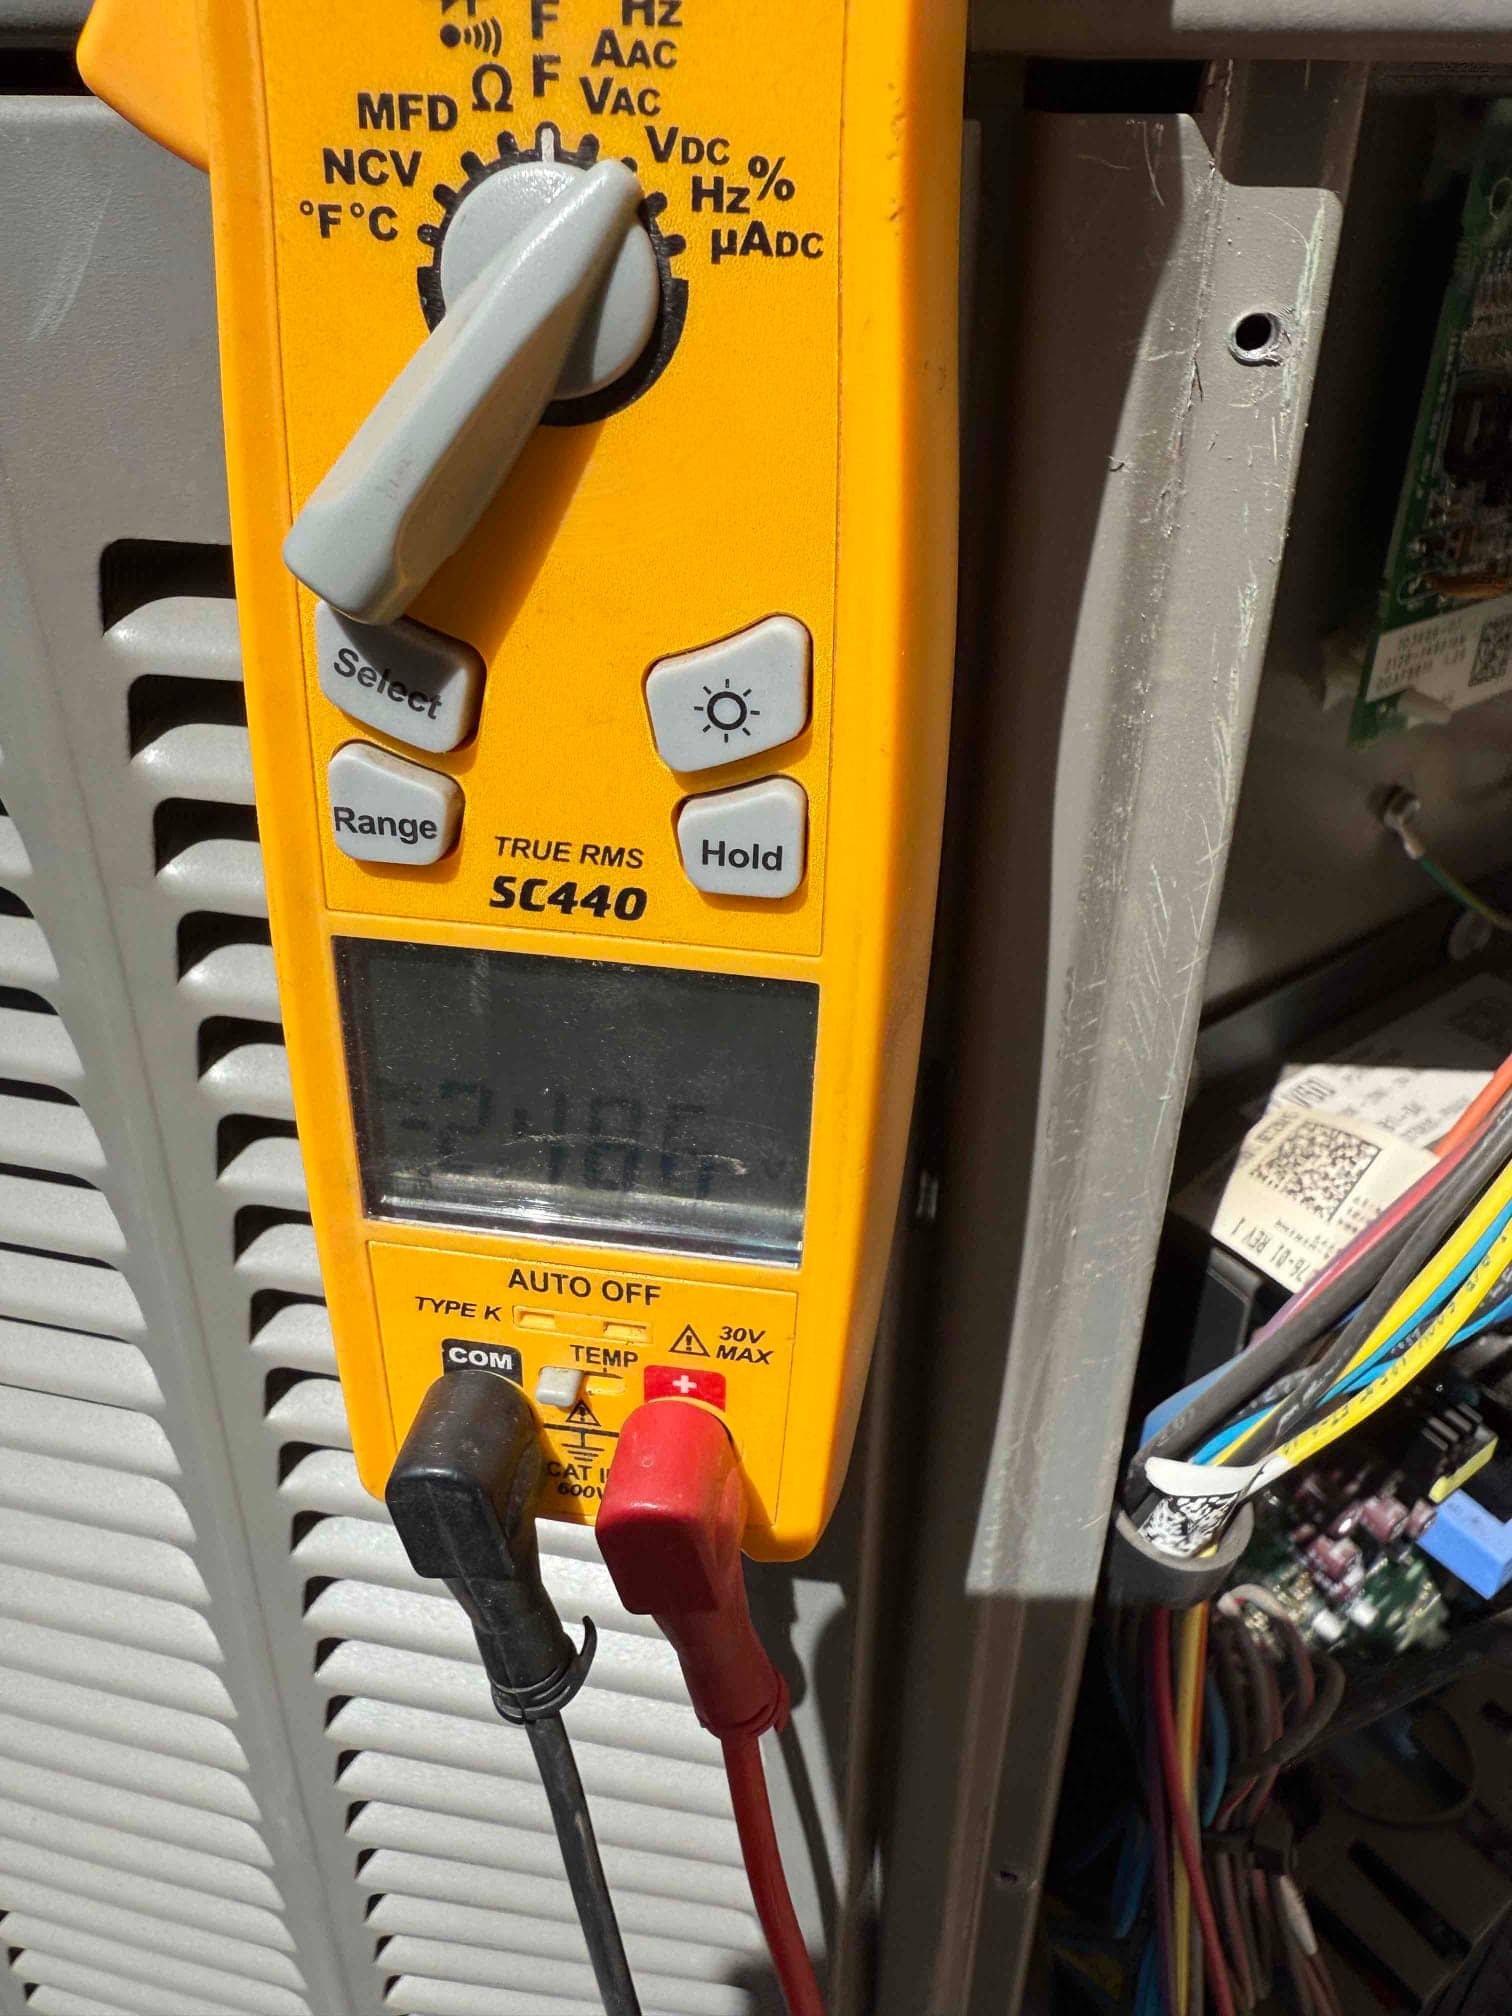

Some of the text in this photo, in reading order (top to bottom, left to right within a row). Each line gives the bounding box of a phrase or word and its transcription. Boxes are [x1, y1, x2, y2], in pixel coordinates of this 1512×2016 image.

[621, 0, 683, 27] Hz
[532, 54, 561, 97] F
[357, 93, 459, 132] MFD
[322, 147, 422, 187] NCV
[333, 647, 443, 721] Select
[333, 805, 438, 845] Range
[494, 836, 645, 869] TRUE RMS
[701, 839, 784, 871] Hold
[489, 875, 648, 921] SC440
[508, 1268, 662, 1306] AUTO OFF
[415, 1296, 503, 1322] TYPE K
[719, 1326, 767, 1344] 30V
[448, 1346, 513, 1370] COM
[570, 1344, 639, 1369] TEMP
[715, 1345, 774, 1365] MAX
[547, 1462, 593, 1480] CAT
